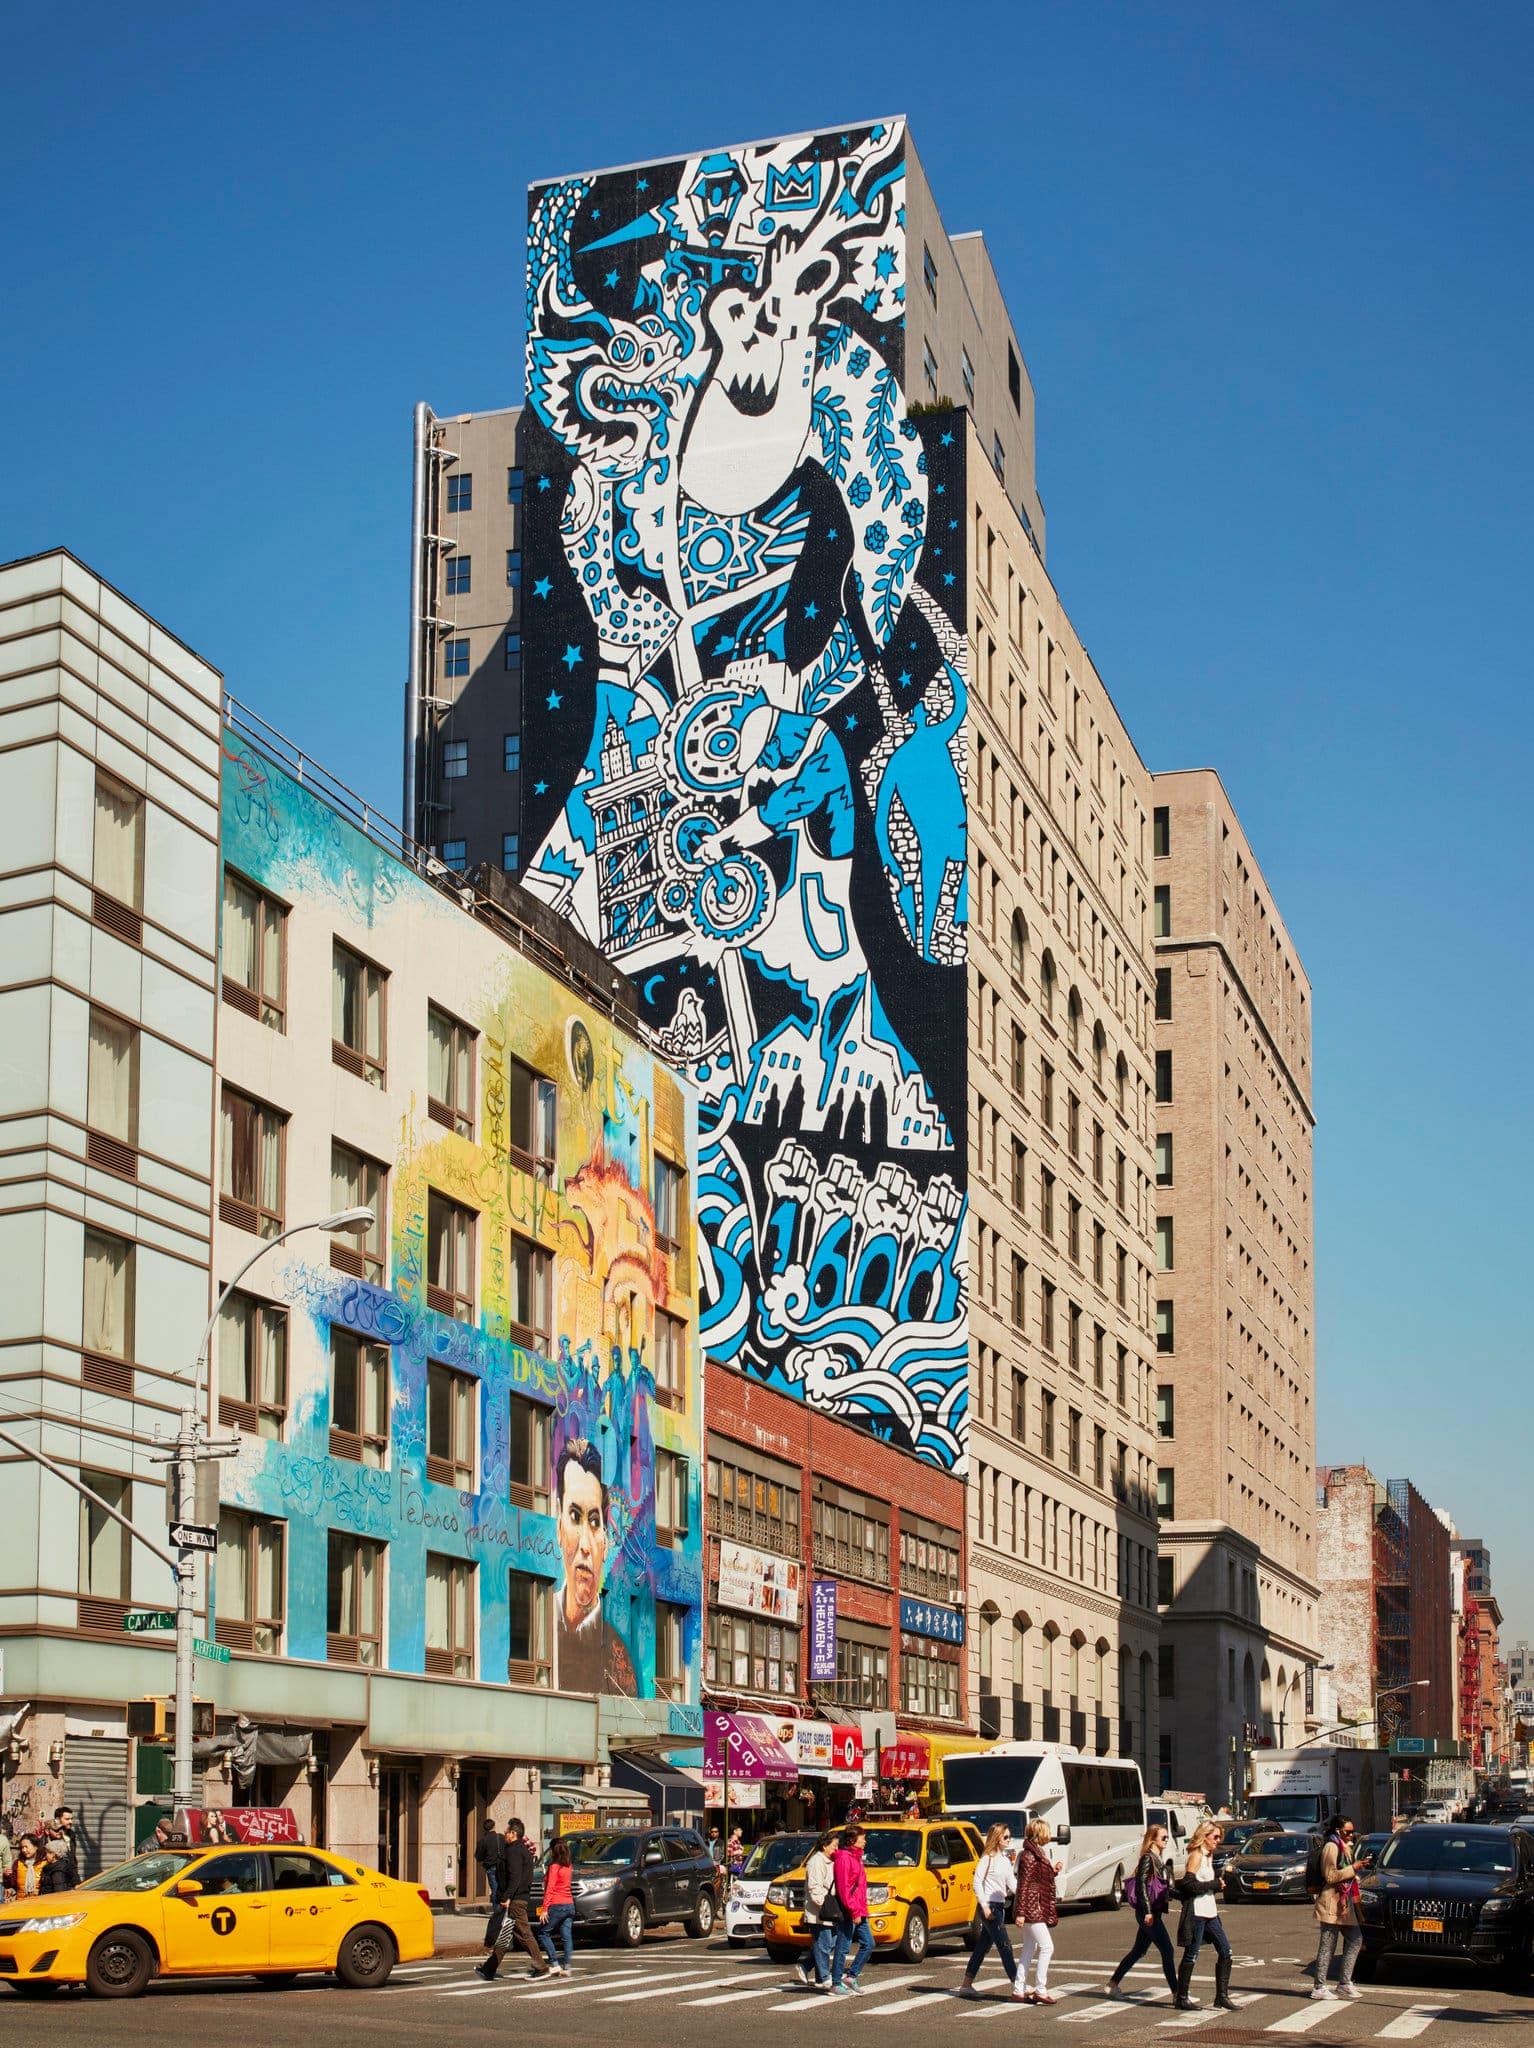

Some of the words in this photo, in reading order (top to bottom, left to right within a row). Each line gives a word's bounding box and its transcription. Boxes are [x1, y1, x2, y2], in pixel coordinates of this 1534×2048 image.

[177, 1530, 192, 1543] ONE
[196, 1534, 213, 1547] WAY
[128, 1615, 164, 1630] CANAL
[826, 1643, 834, 1660] SPA
[715, 1716, 757, 1767] spa
[777, 1727, 794, 1741] ups
[239, 1814, 289, 1836] CATCH
